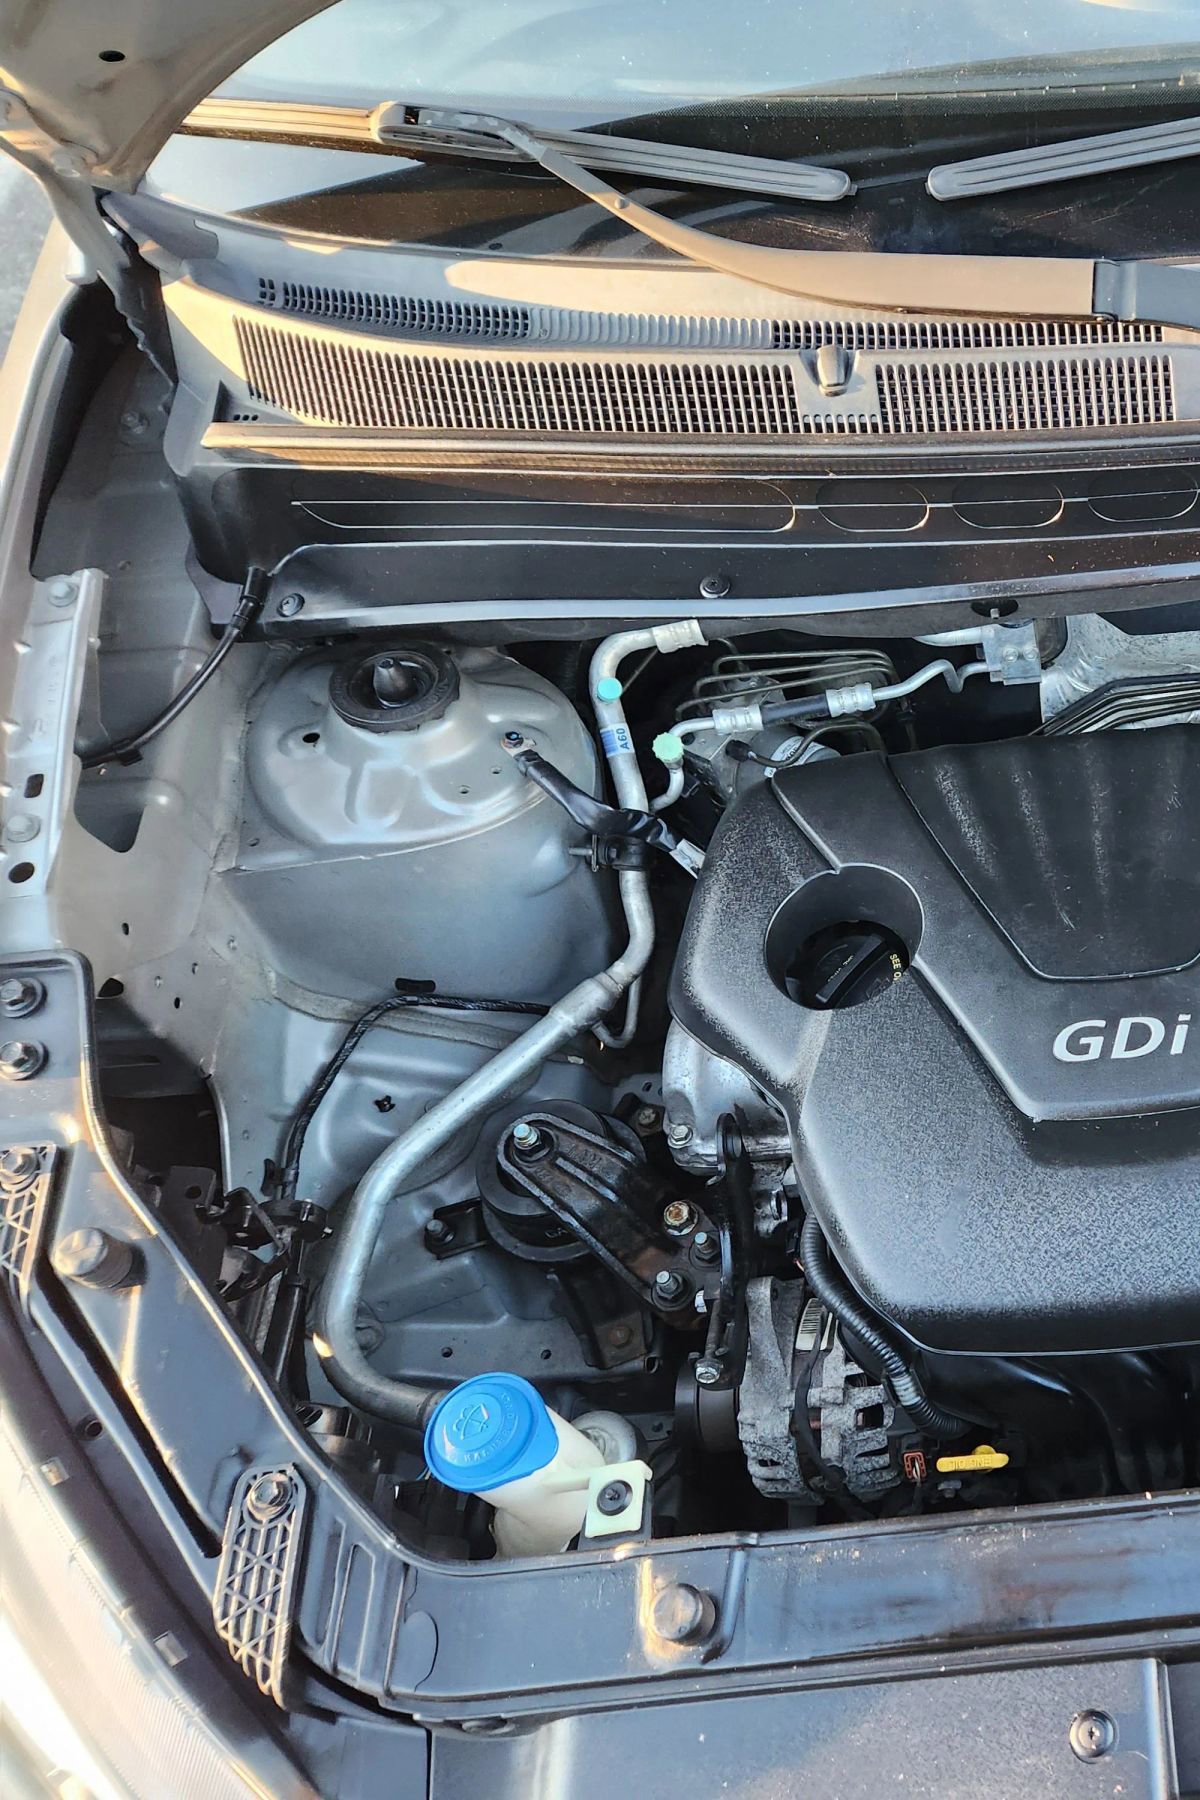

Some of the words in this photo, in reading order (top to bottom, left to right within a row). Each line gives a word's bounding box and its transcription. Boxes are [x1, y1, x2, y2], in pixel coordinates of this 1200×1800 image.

[615, 727, 631, 750] A60
[889, 953, 902, 970] SEE
[1052, 1013, 1193, 1063] GDi
